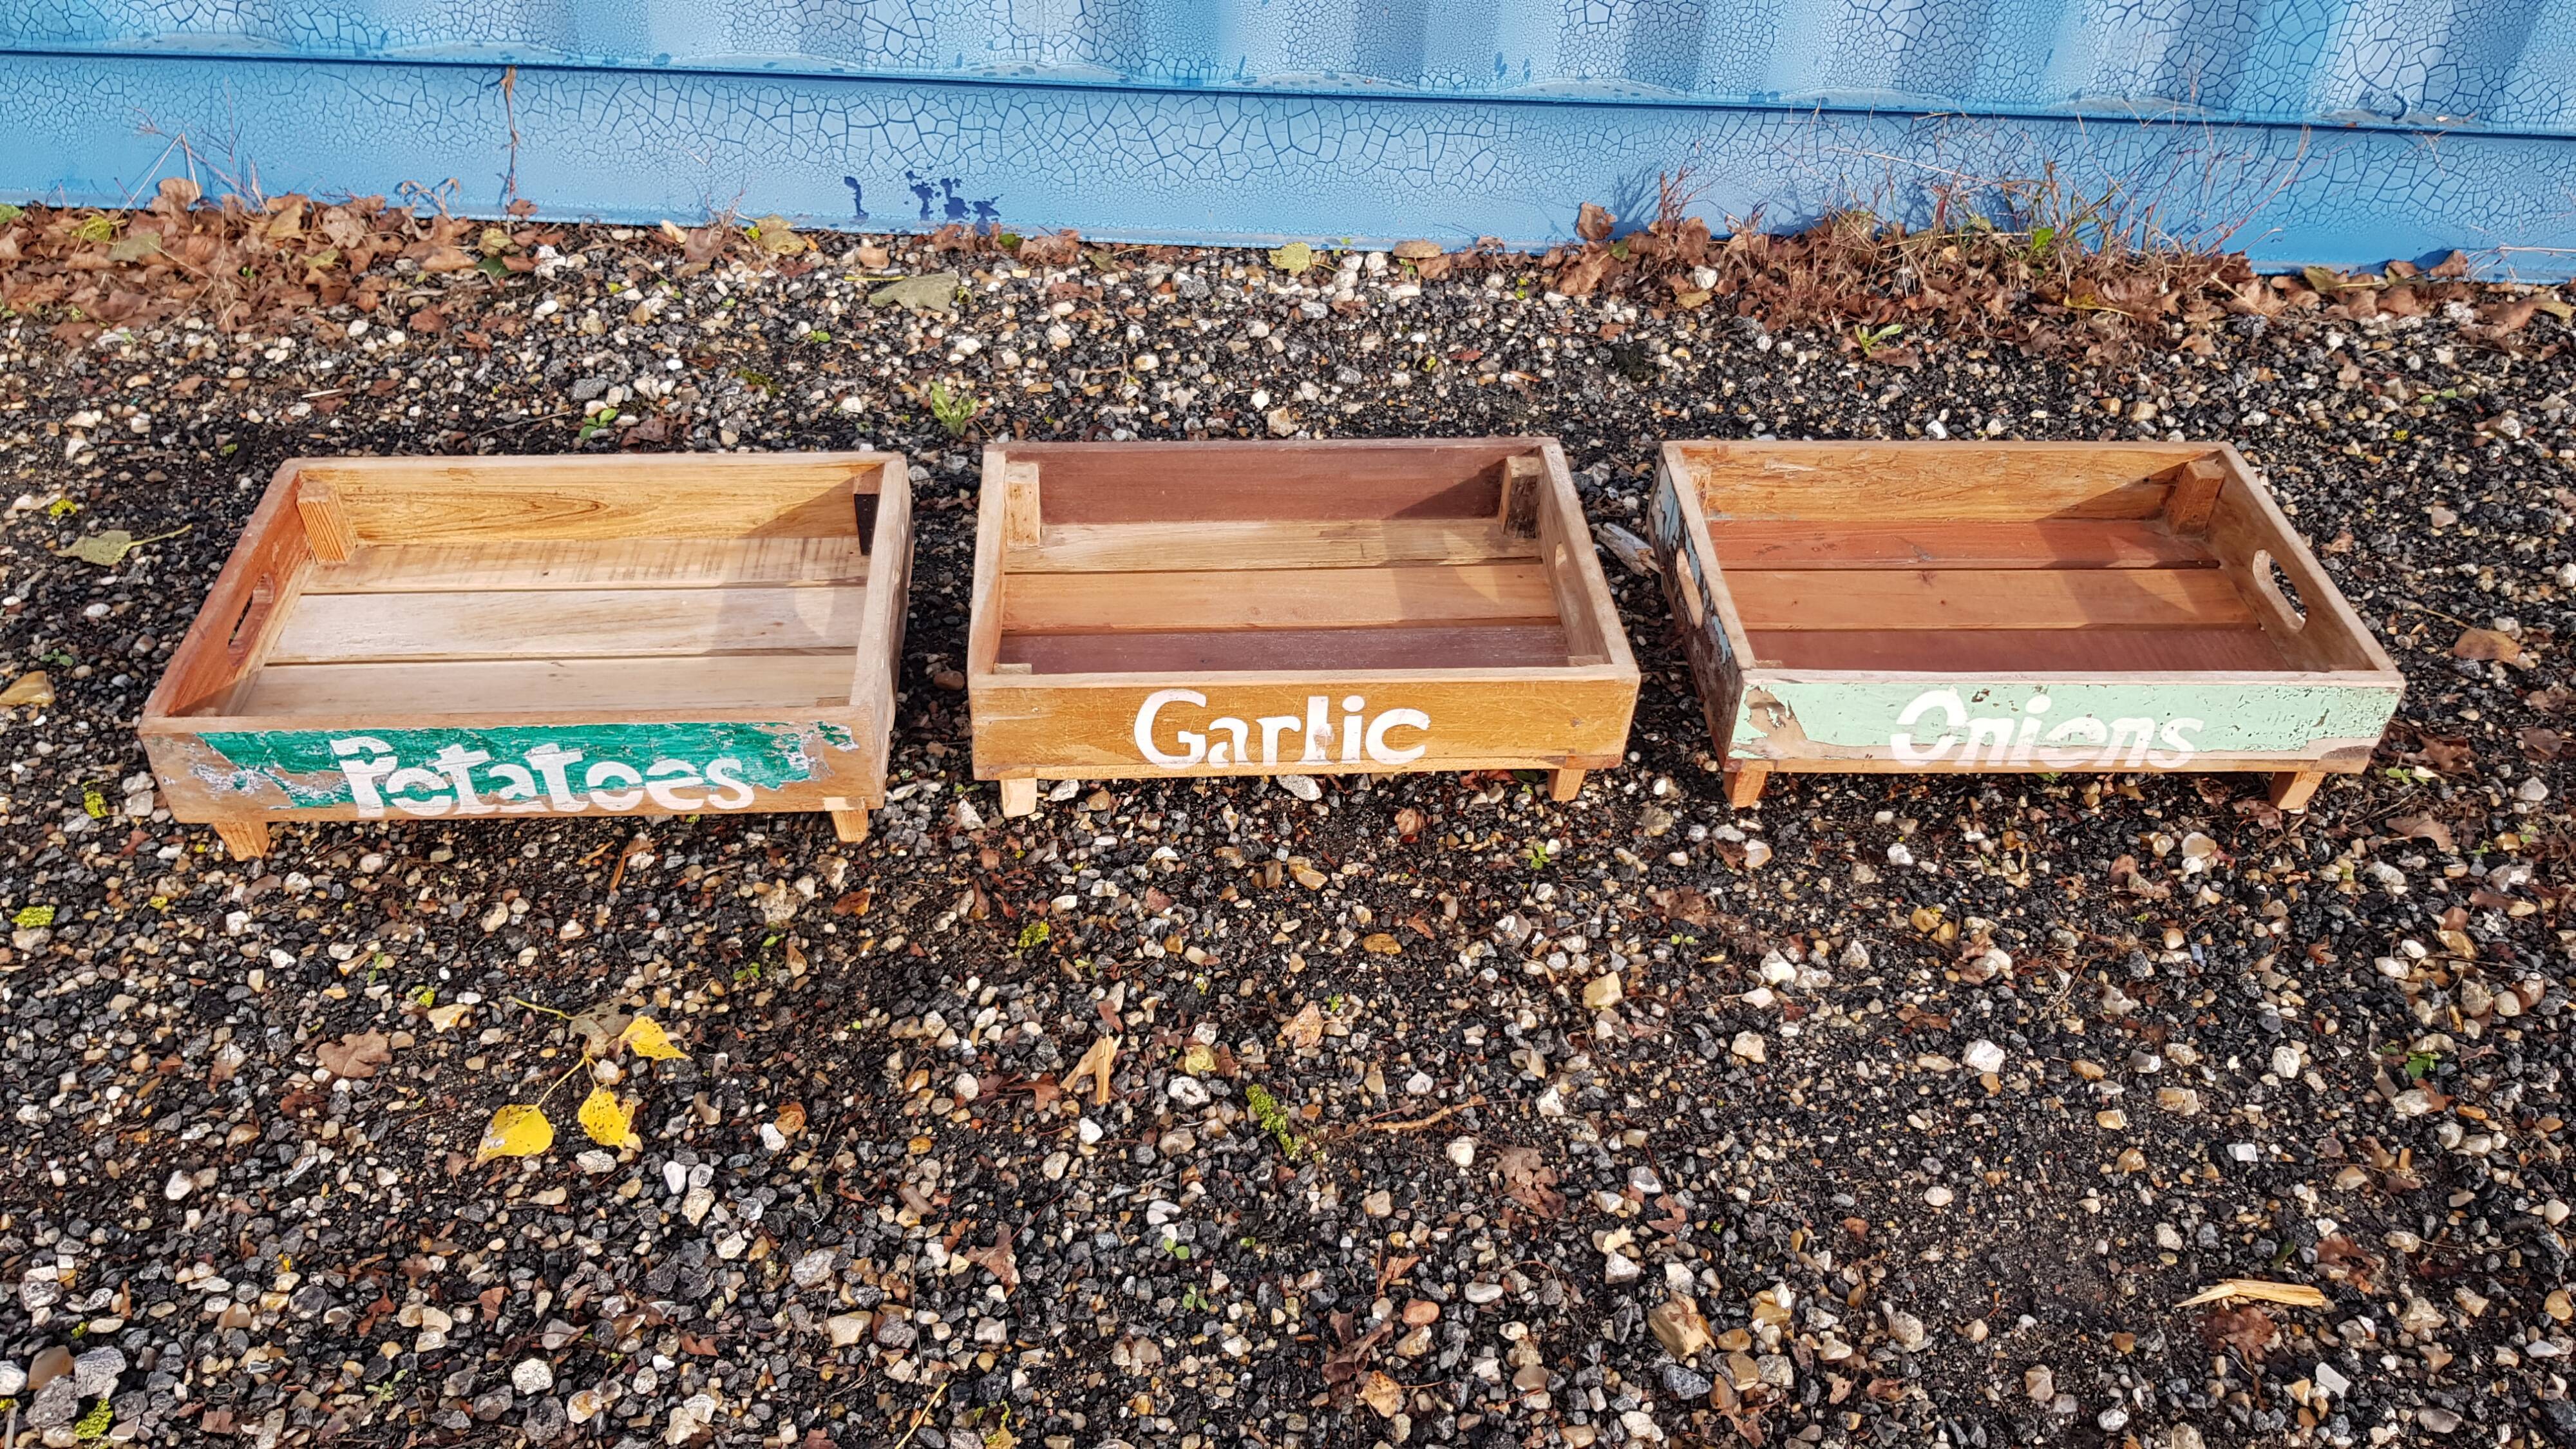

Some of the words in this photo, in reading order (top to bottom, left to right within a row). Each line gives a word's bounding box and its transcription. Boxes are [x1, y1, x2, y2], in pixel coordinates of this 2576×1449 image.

[1133, 688, 1430, 769] Garlic
[1890, 686, 2204, 768] Onions
[330, 736, 754, 817] Potatoes
